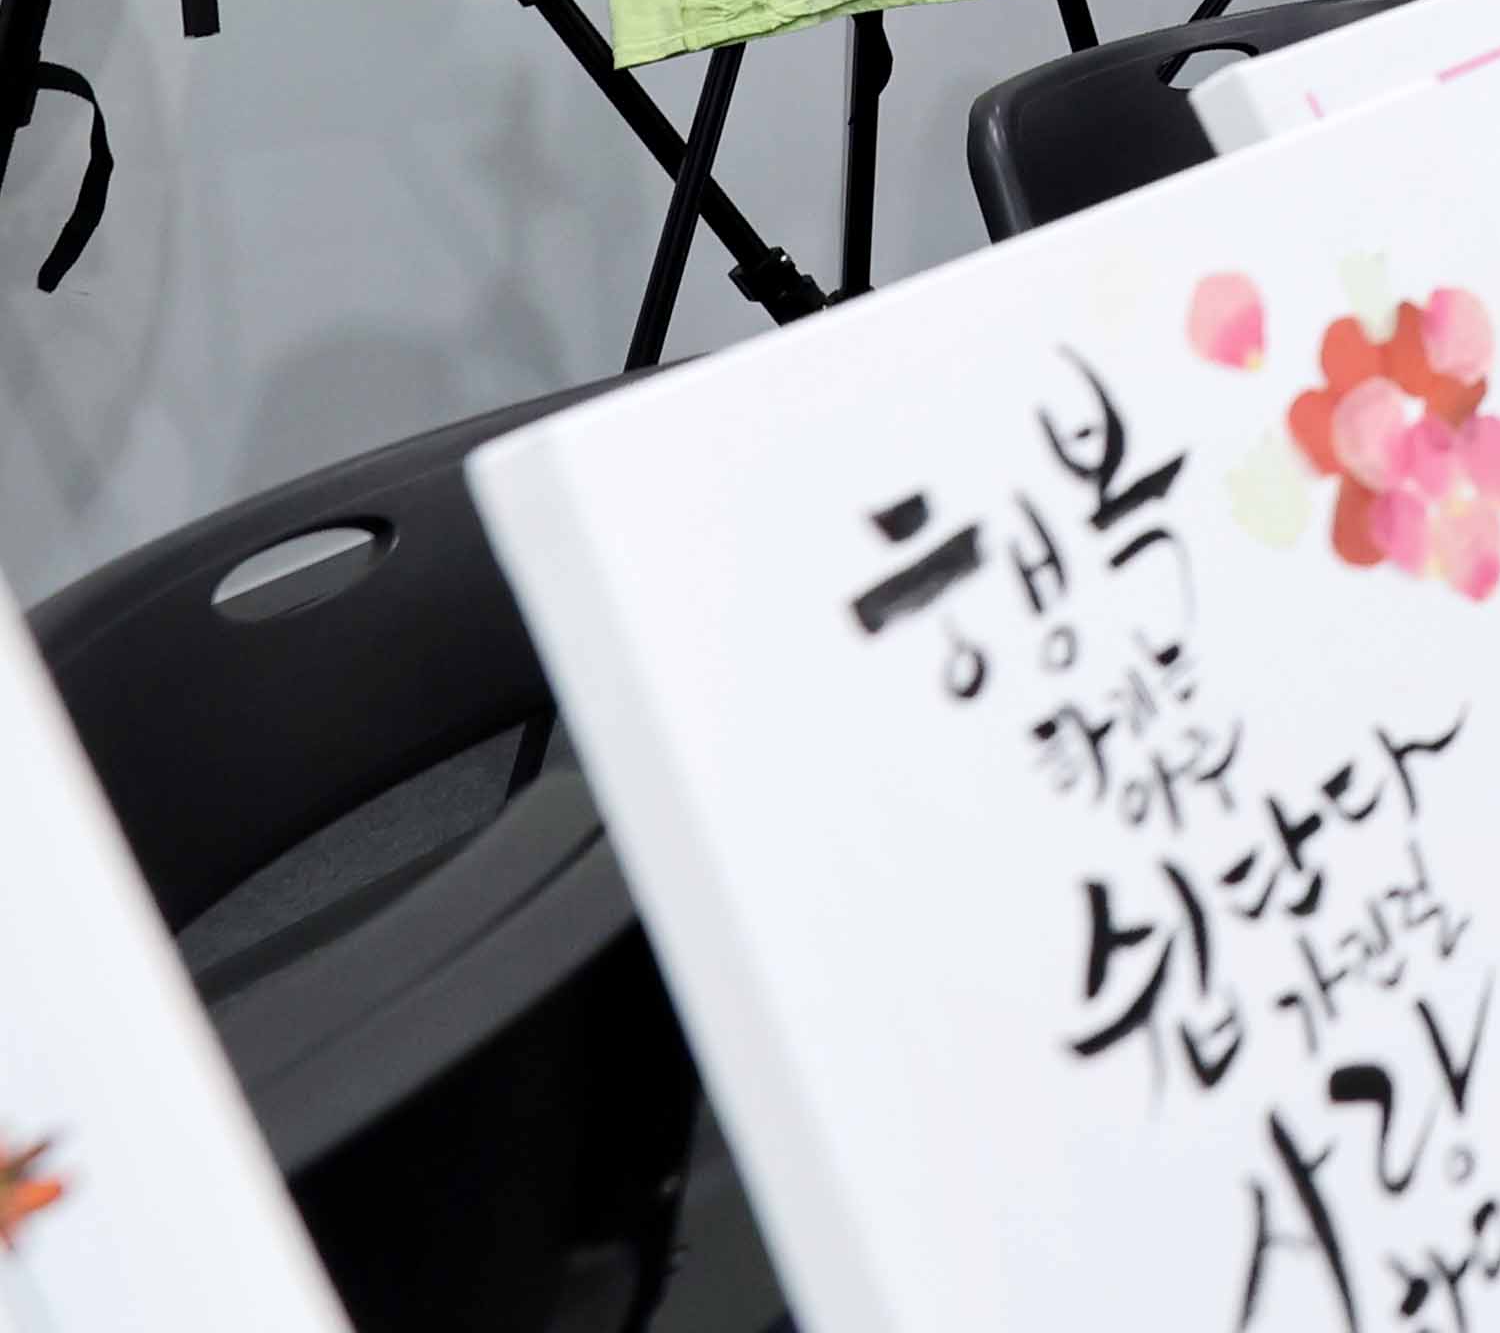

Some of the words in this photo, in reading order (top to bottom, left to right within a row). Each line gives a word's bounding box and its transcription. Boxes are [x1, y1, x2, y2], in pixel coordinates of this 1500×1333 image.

[850, 343, 1190, 705] 행복
[1066, 699, 1472, 1123] 쉽단다
[1118, 718, 1247, 833] 아주
[1238, 963, 1497, 1333] 사랑
